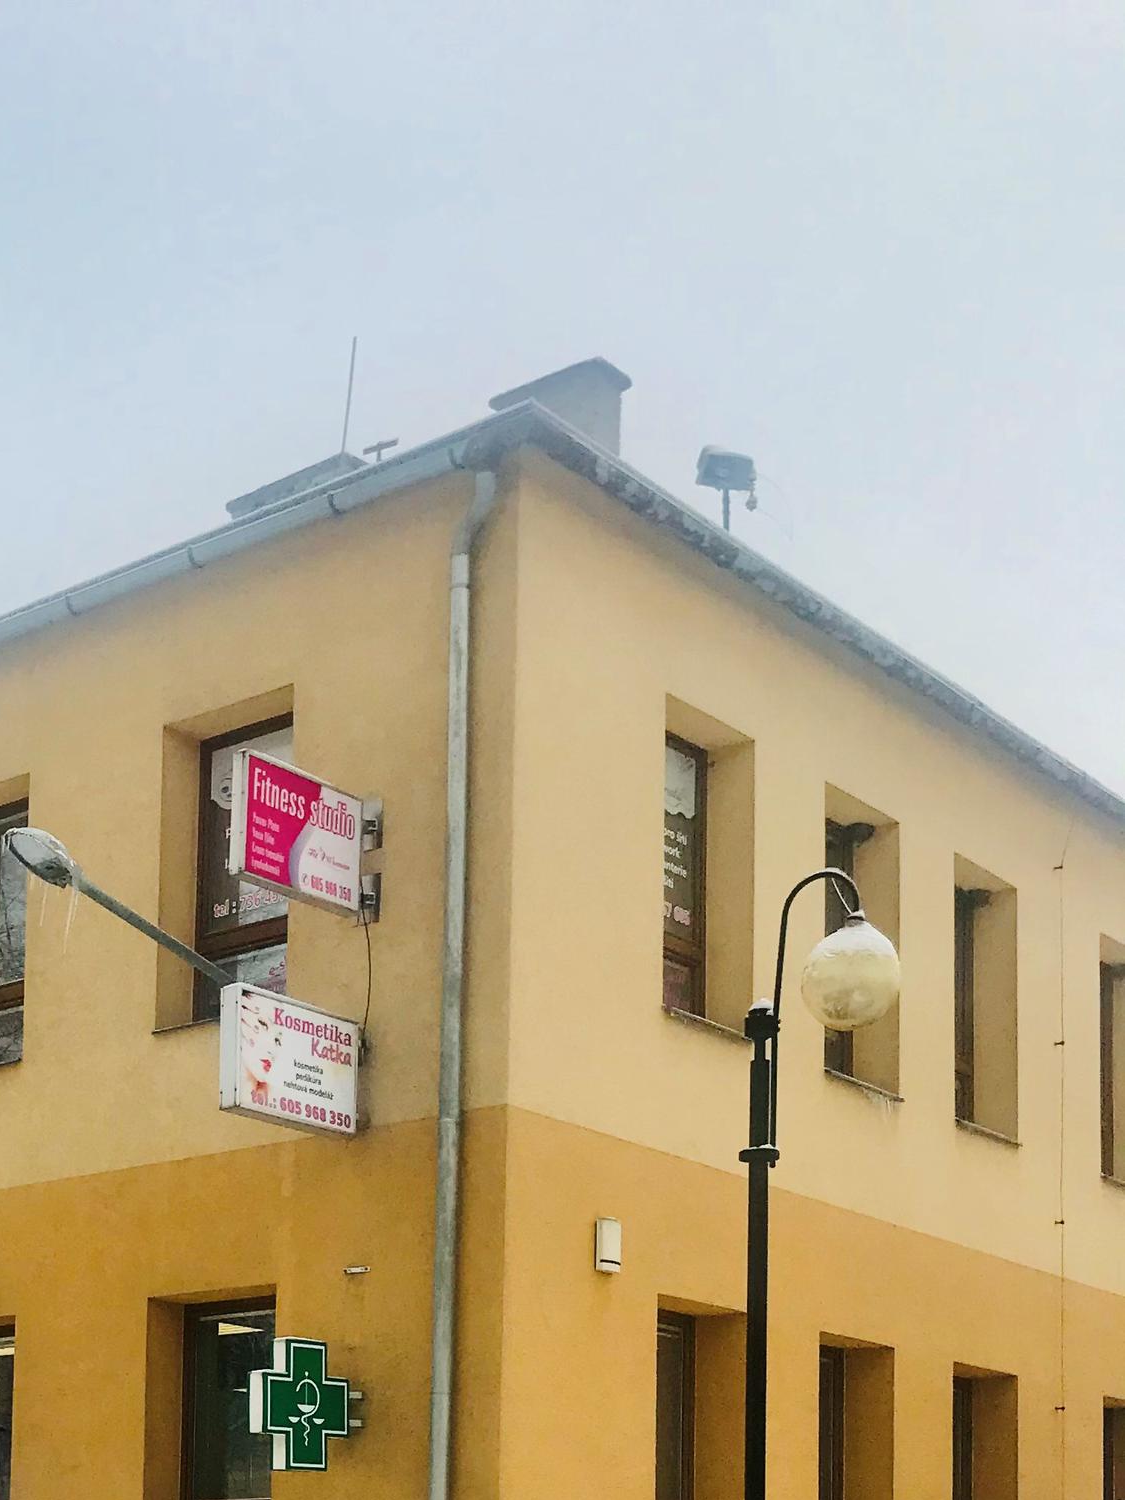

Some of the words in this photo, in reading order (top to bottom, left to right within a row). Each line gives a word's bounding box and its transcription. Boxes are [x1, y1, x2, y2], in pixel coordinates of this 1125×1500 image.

[253, 767, 305, 820] Fitness
[309, 800, 355, 840] studio
[273, 1007, 352, 1047] Kosmetika
[293, 1059, 324, 1075] kosmetika
[311, 1037, 353, 1067] Katka
[250, 1089, 277, 1109] tel.:
[279, 1096, 302, 1115] 605
[304, 1103, 327, 1122] 968
[329, 1109, 352, 1129] 350
